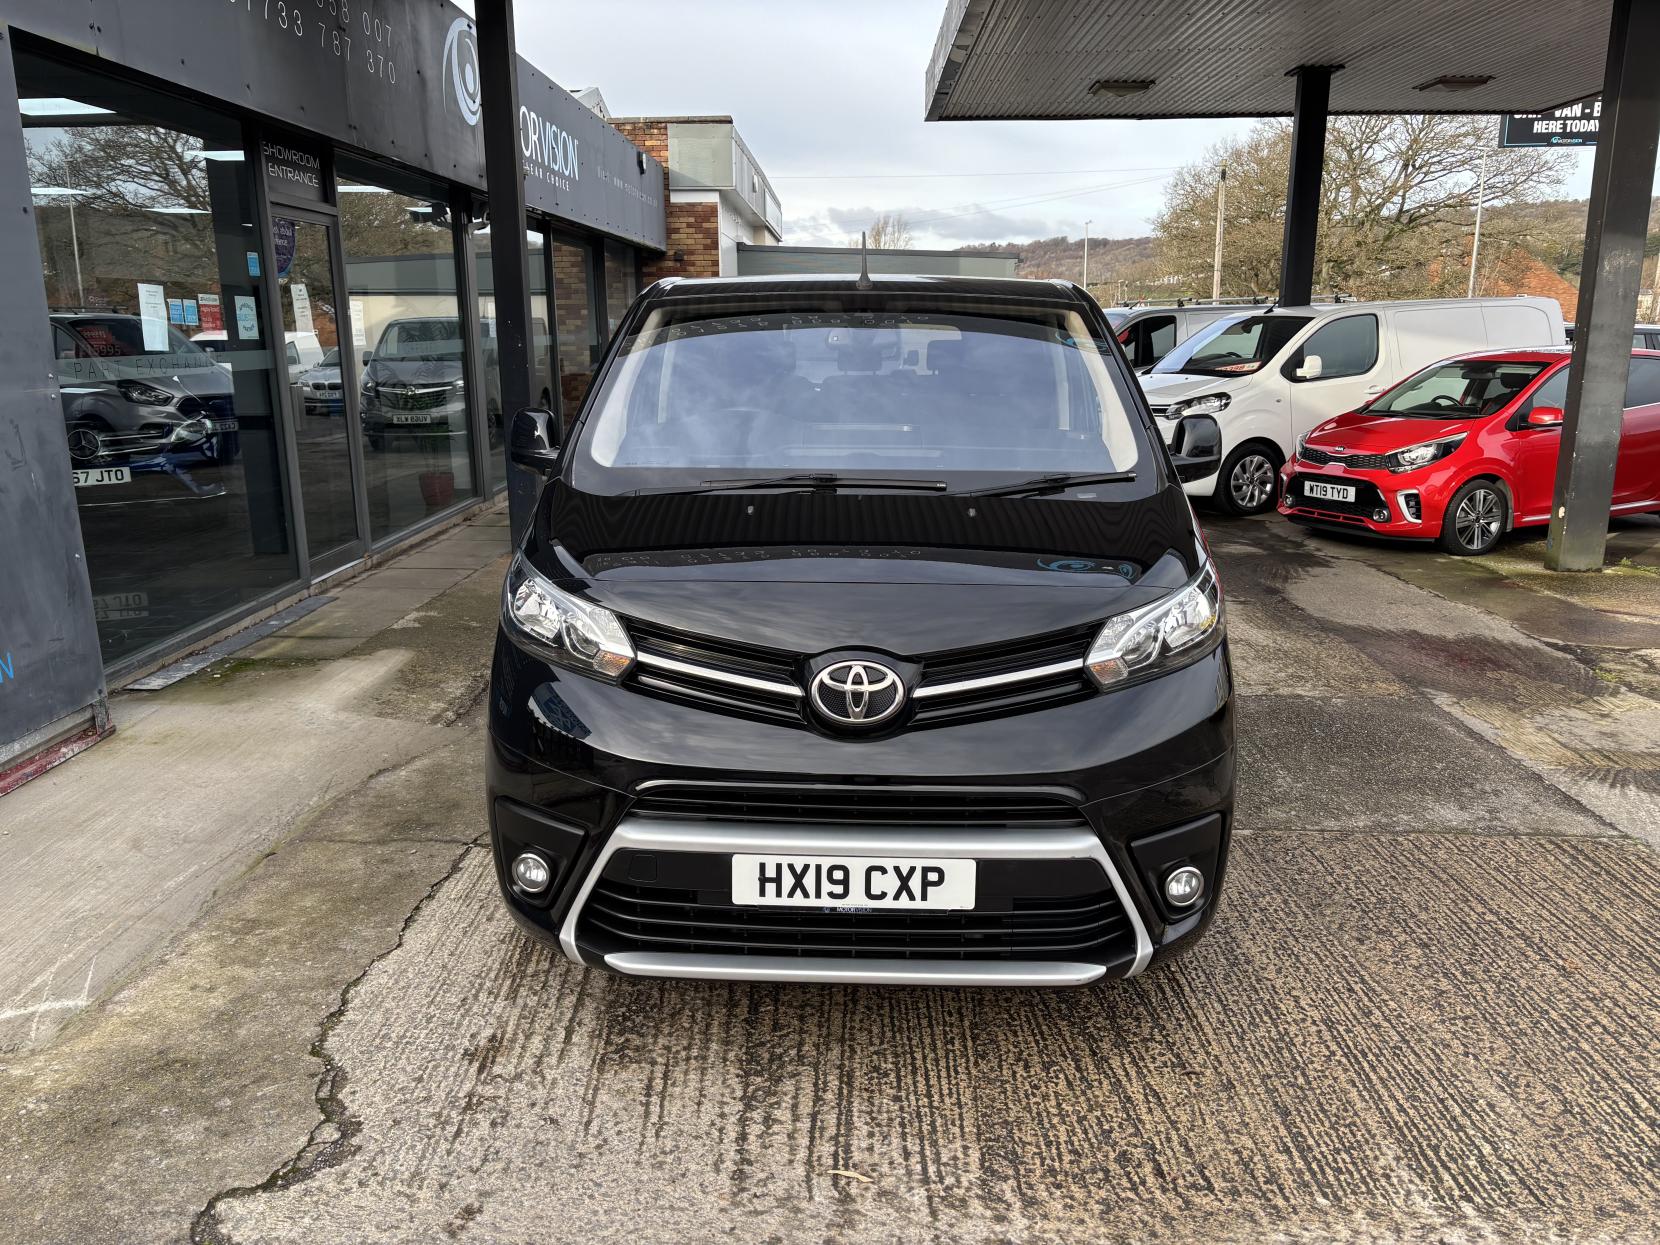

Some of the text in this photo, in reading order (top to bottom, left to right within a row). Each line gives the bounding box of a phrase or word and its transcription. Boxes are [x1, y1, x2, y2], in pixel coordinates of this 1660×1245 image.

[362, 11, 392, 48] 007
[318, 22, 351, 61] 787
[366, 50, 397, 84] 370
[1533, 119, 1600, 133] HERE TODAY
[263, 143, 320, 169] SHOWROOM
[268, 162, 320, 187] ENTRANCE
[73, 359, 120, 381] PART
[96, 469, 125, 483] JTO
[1330, 486, 1349, 500] TYD
[758, 862, 946, 901] HX19 CXP
